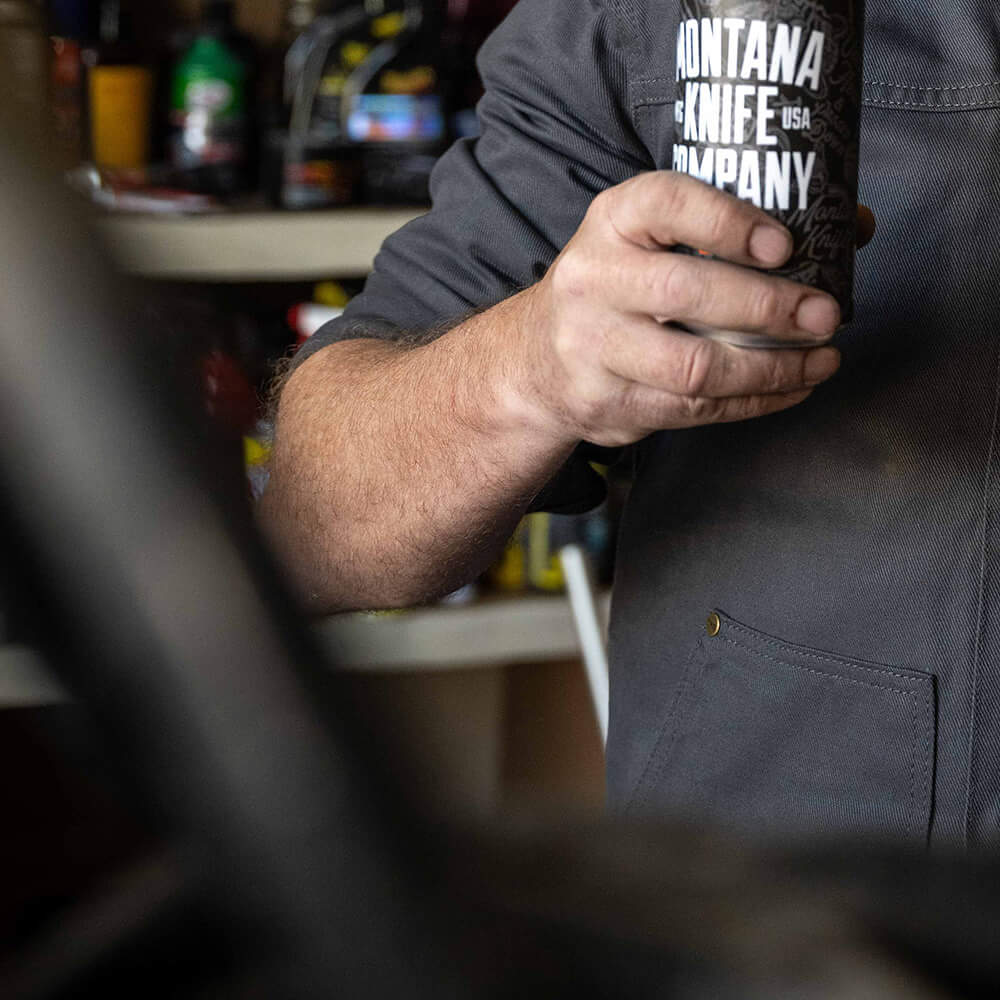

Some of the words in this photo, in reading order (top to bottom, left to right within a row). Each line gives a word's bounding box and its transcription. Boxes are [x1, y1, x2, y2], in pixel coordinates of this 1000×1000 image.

[684, 82, 779, 146] KNIFE
[781, 106, 811, 131] USA
[673, 143, 817, 211] OMPANY
